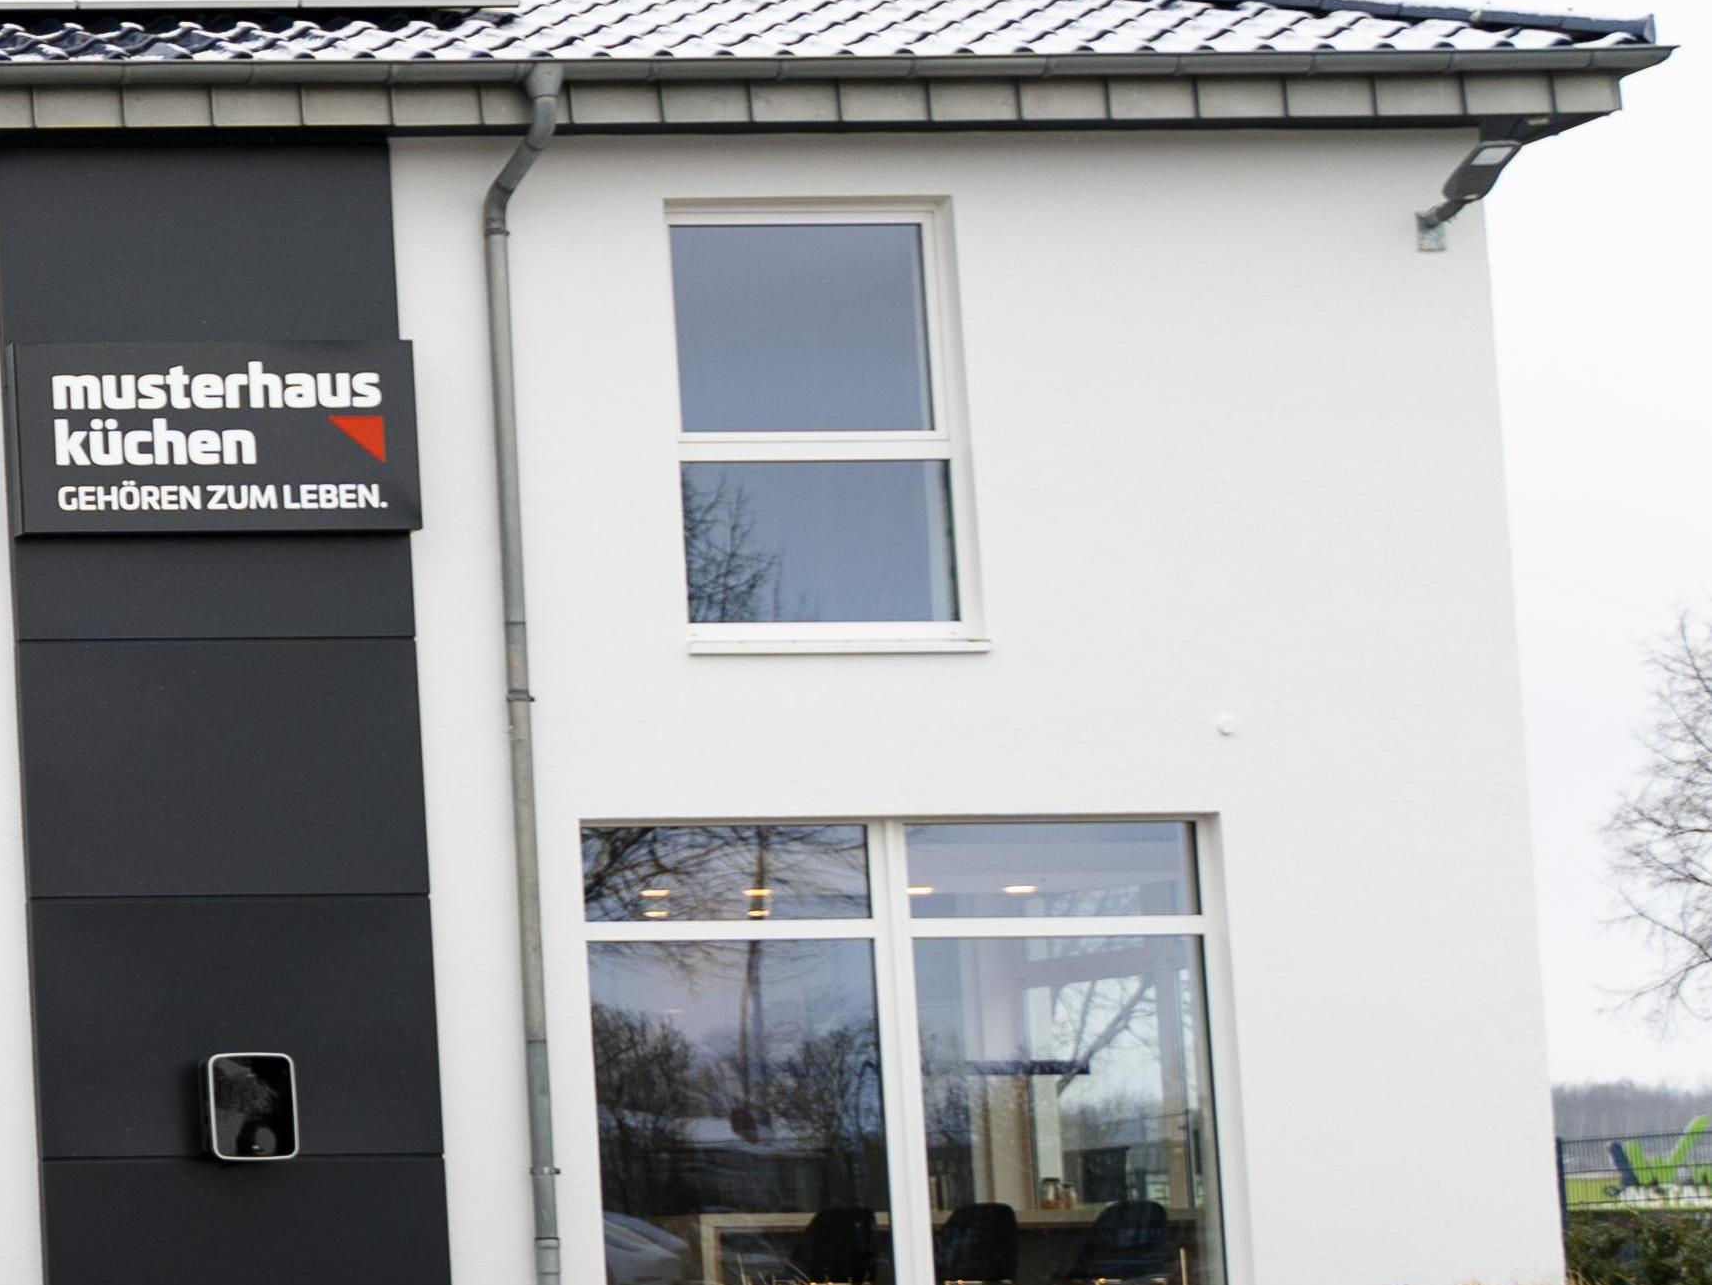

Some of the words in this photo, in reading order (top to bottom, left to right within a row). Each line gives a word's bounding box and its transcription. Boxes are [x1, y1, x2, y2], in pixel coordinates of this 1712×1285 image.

[52, 361, 382, 410] musterhaus
[53, 418, 257, 466] küchen
[57, 481, 202, 511] GEHÖREN
[206, 485, 277, 510] ZUM
[283, 483, 388, 510] LEBEN.
